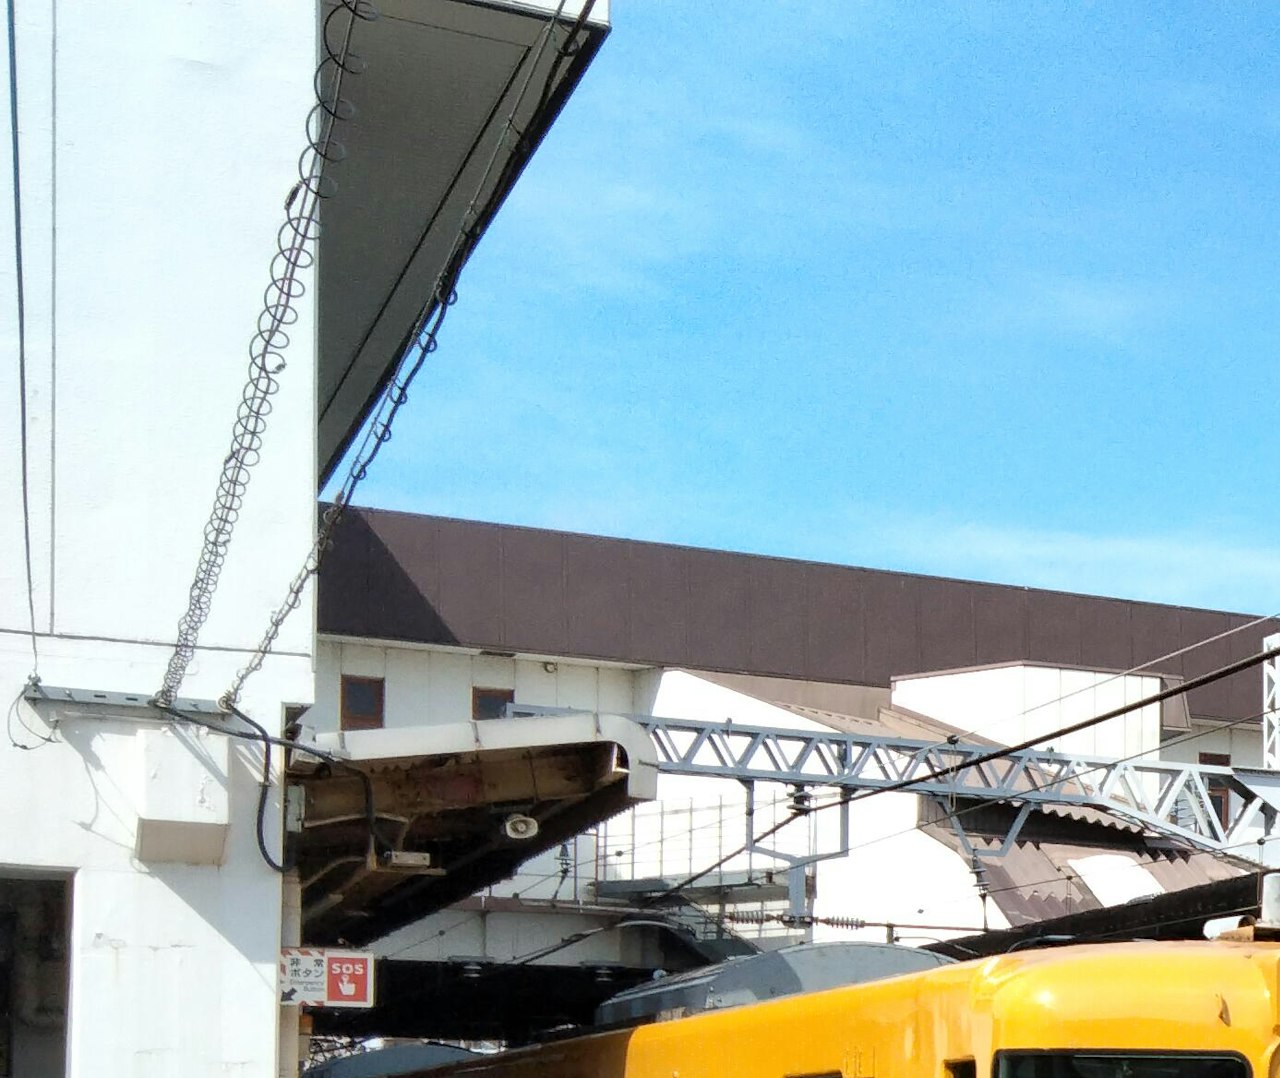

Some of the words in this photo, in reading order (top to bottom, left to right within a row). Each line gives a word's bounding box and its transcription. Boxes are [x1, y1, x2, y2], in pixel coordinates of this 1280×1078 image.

[290, 967, 324, 978] ボタン
[331, 963, 364, 975] SOS
